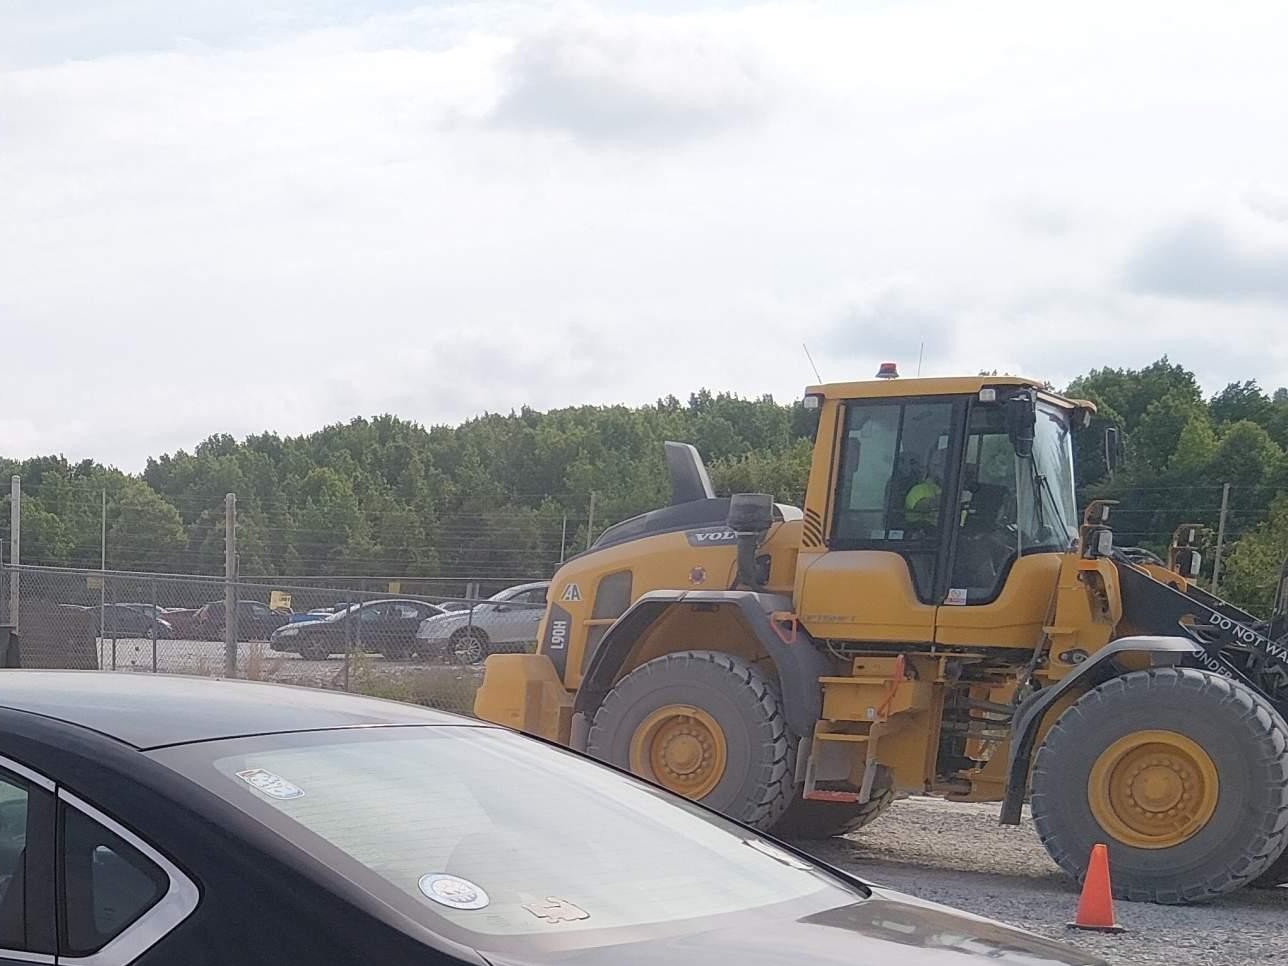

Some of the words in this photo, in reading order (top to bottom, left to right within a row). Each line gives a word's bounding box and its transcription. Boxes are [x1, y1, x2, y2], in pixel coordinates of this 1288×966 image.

[695, 532, 739, 541] VOL
[550, 620, 567, 649] L90H
[1209, 613, 1232, 630] DO
[1232, 625, 1265, 646] NOT
[1265, 642, 1288, 663] WA
